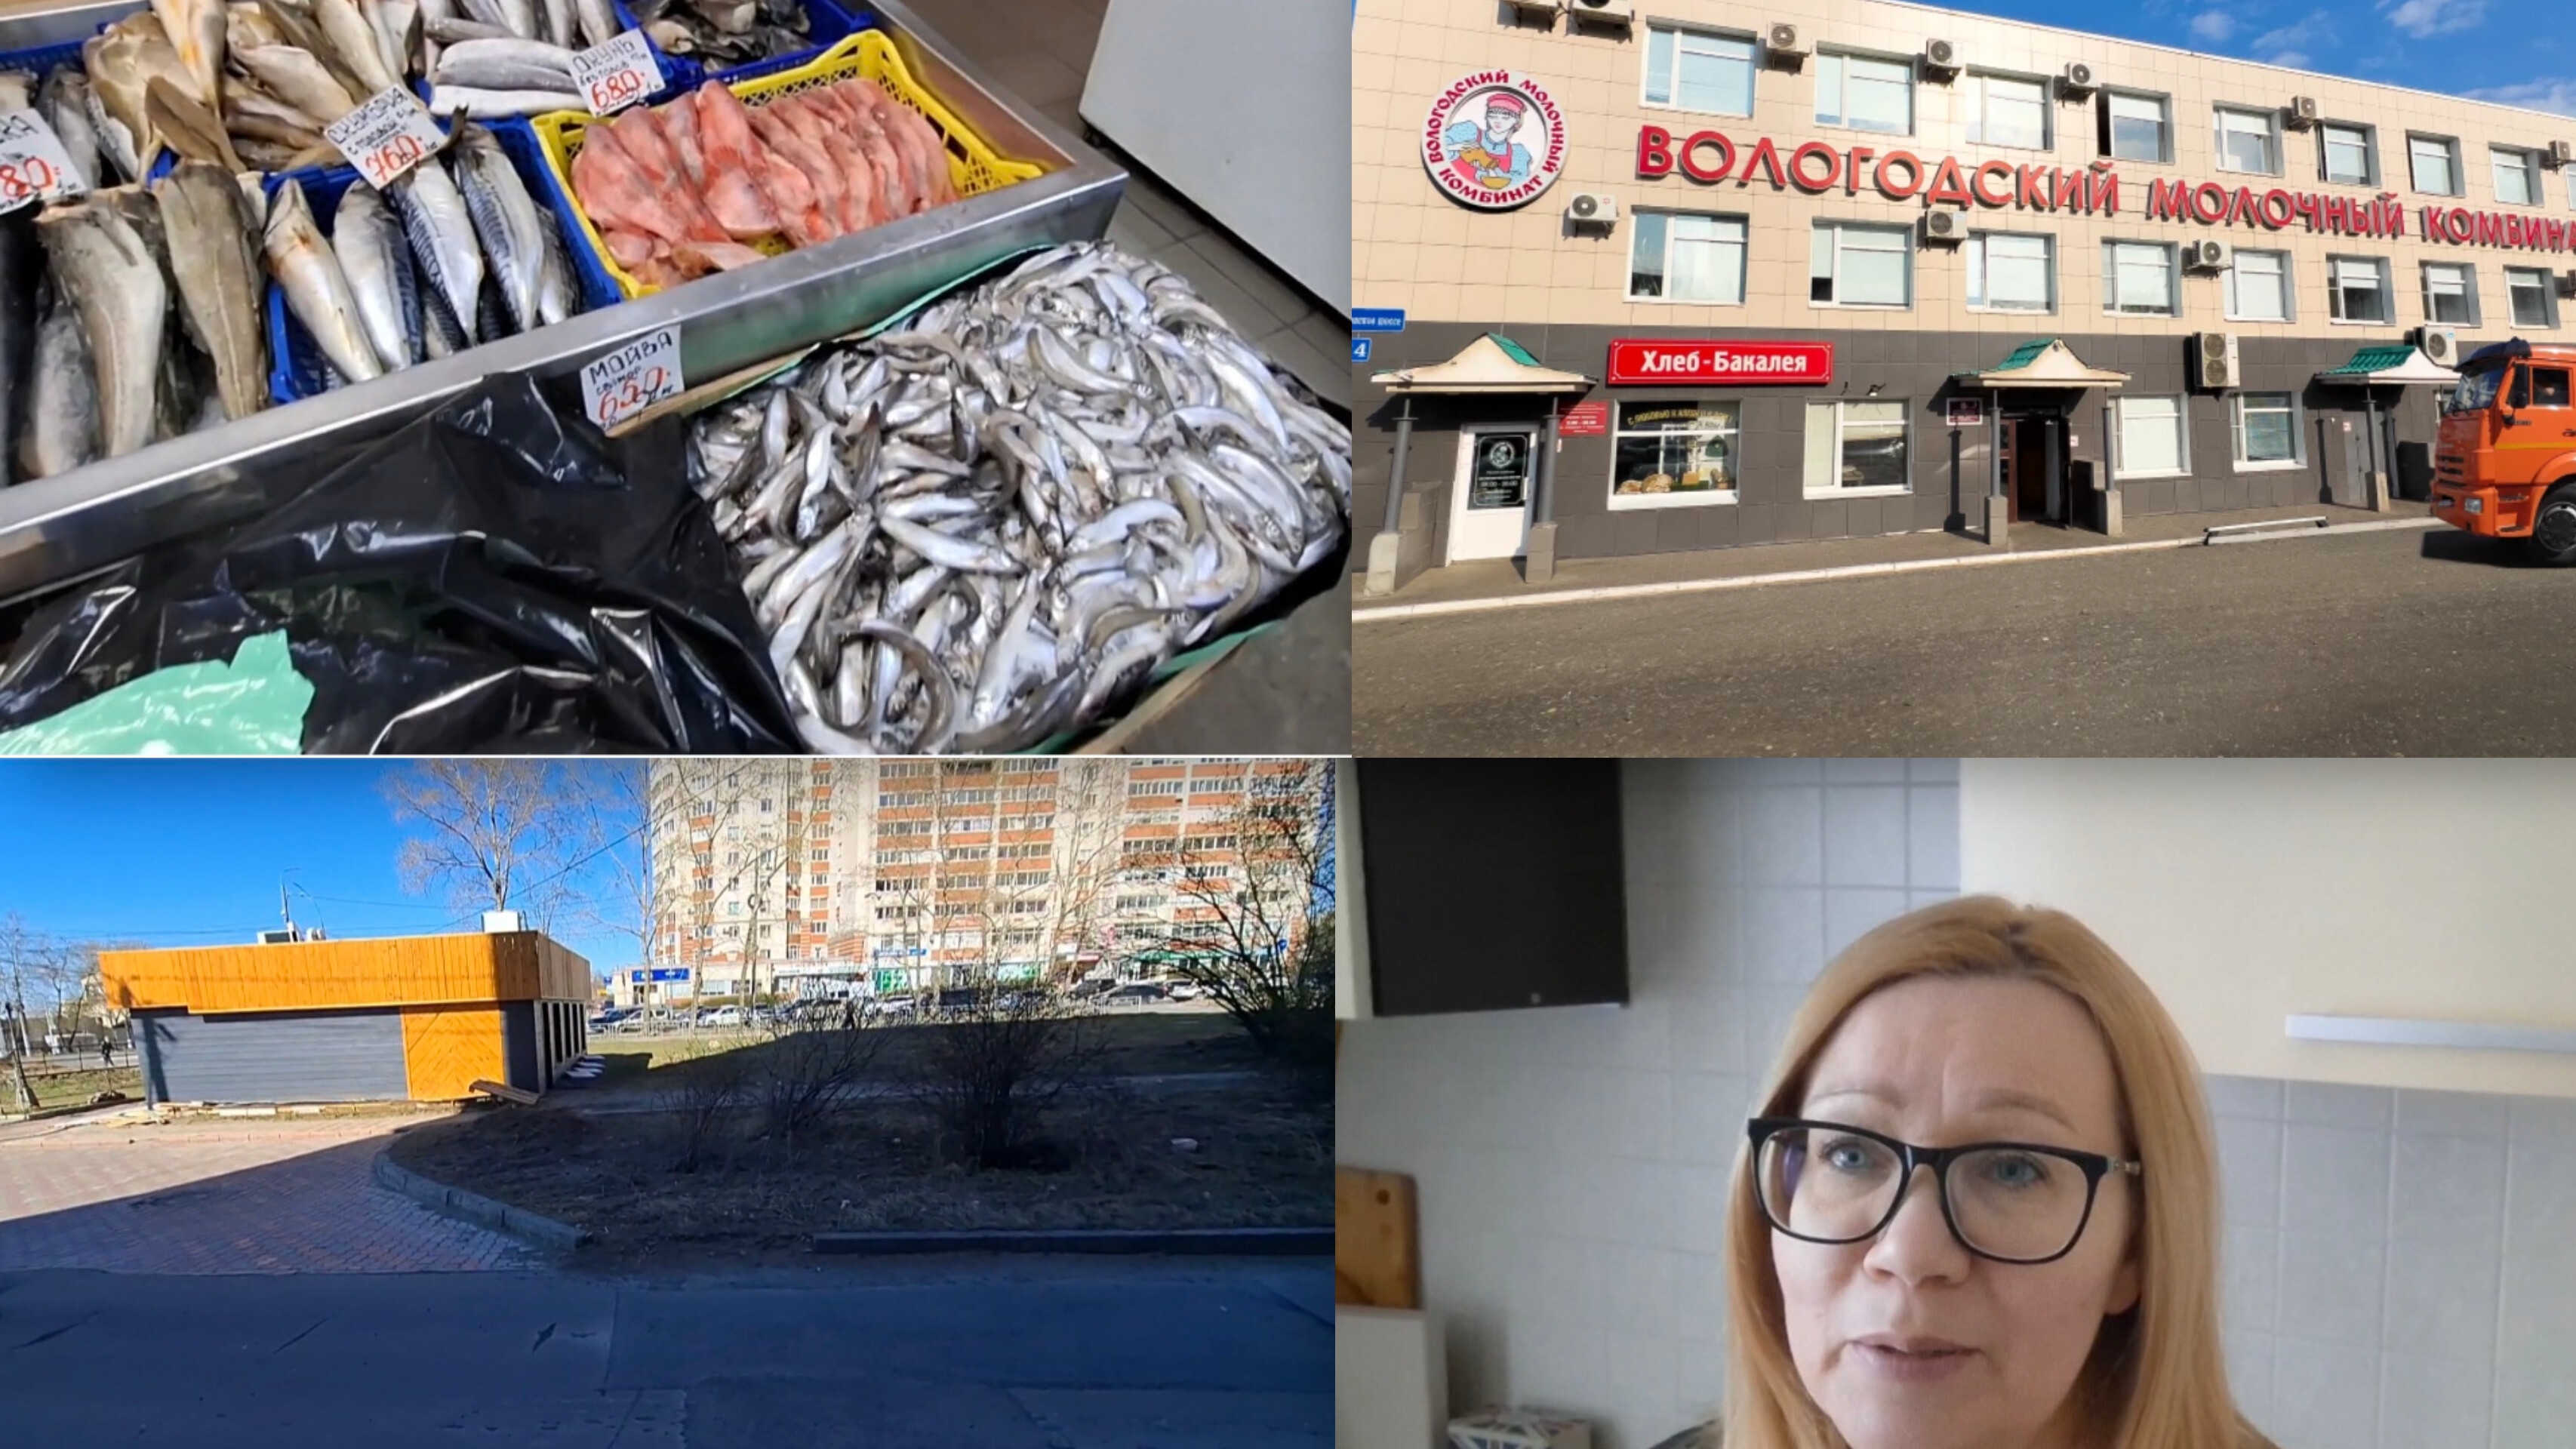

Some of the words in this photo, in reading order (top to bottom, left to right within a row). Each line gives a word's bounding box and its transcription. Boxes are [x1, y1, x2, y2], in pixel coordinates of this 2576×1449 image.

[1426, 69, 1509, 163] ВОЛОГОДСКИЙ
[1519, 79, 1564, 174] МОЛОЧНЫЙ
[1439, 168, 1543, 203] КОМБИНАТ
[1637, 124, 2119, 214] ВОЛОГОДСКИЙ
[2149, 177, 2405, 236] МОЛОЧНЫЙ
[589, 331, 672, 386] МОЙВА
